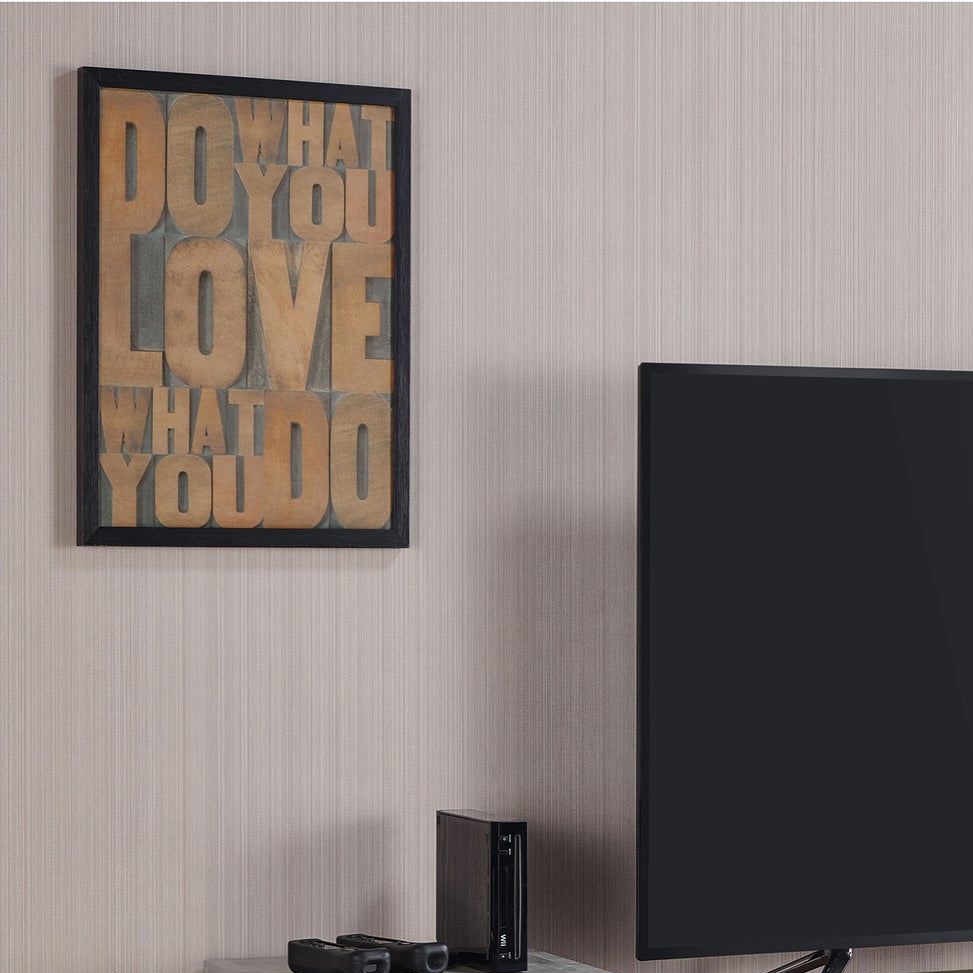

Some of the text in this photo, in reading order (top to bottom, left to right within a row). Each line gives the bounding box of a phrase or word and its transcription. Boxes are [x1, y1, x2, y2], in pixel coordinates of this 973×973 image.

[100, 90, 395, 236] DO WHAT
[233, 164, 395, 244] YOU
[99, 233, 395, 393] LOVE
[99, 391, 393, 530] YOU DO
[100, 387, 264, 455] WHAT
